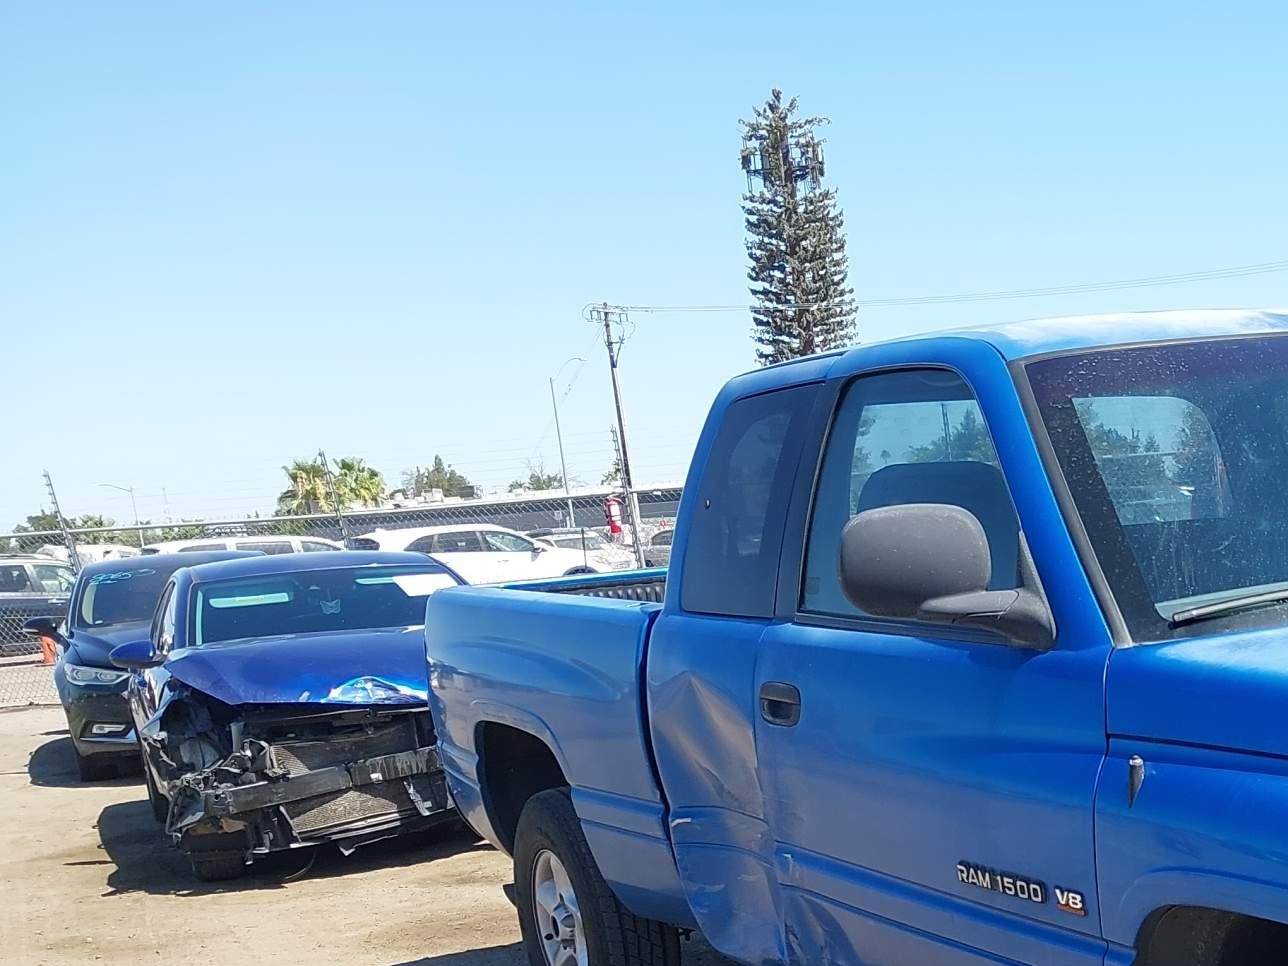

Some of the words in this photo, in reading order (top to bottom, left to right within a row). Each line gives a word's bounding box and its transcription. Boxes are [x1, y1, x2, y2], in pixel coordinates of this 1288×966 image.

[956, 863, 992, 889] RAM
[996, 873, 1043, 903] 1500
[1054, 887, 1084, 910] V8
